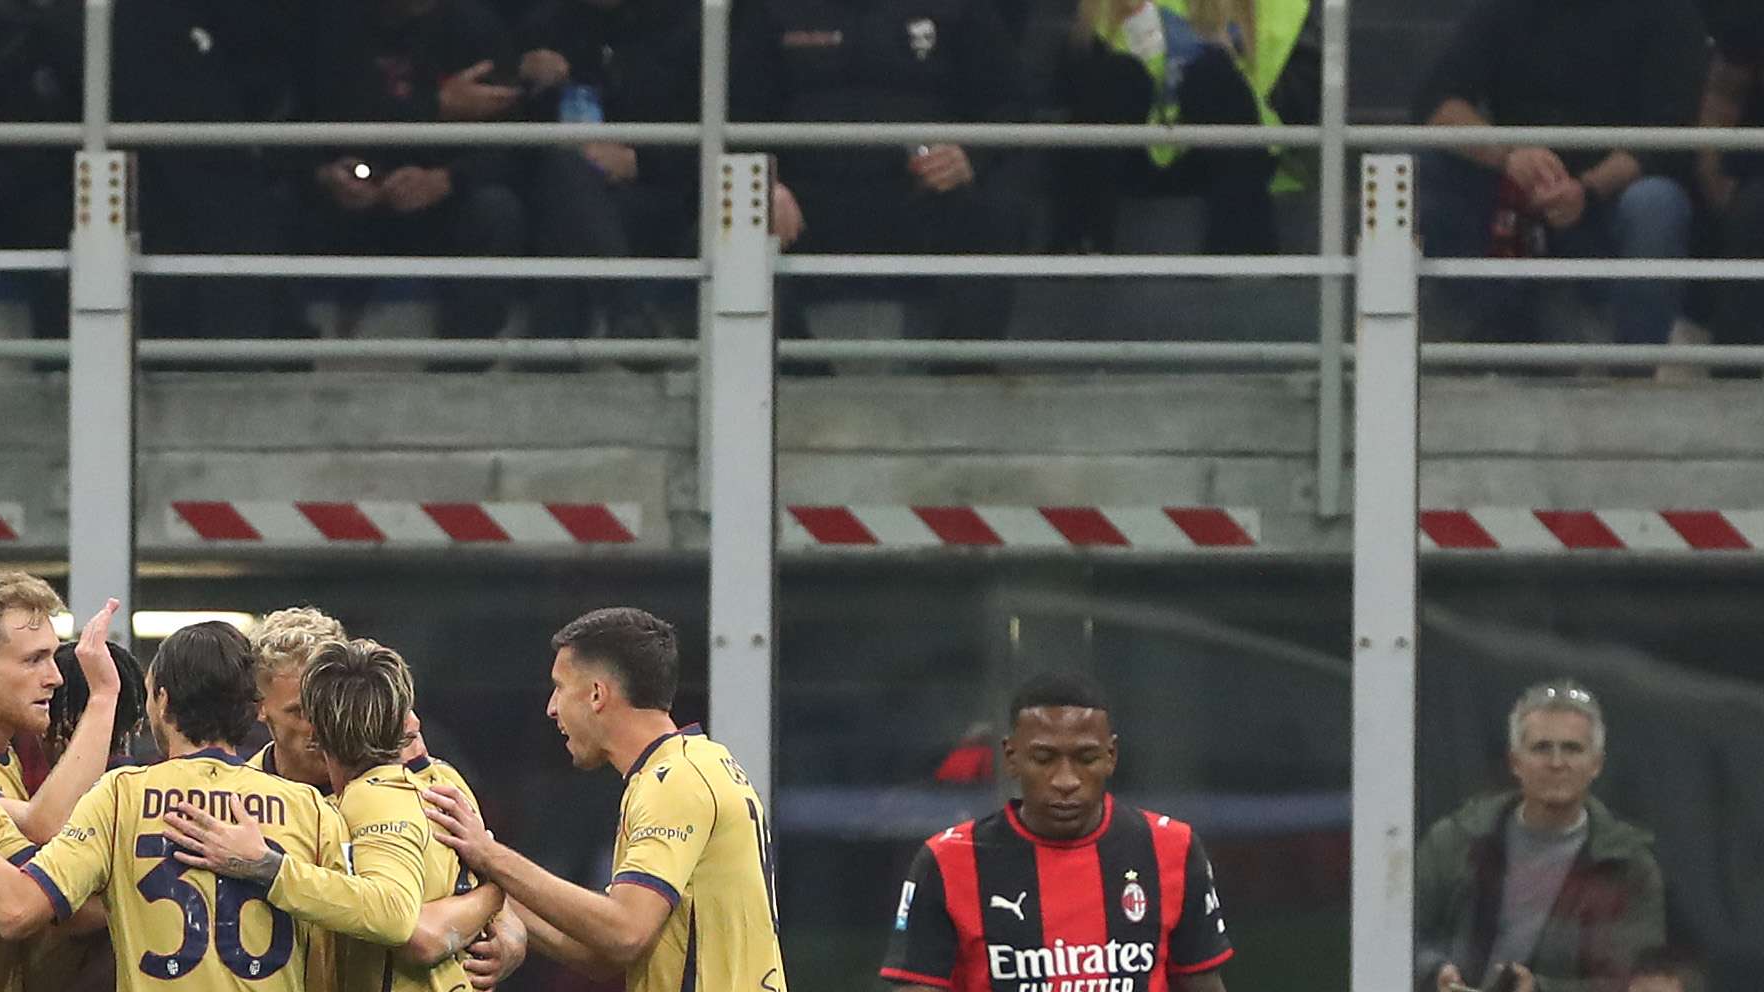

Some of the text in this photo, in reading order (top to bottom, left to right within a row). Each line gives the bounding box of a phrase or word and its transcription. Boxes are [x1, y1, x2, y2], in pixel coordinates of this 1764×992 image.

[142, 788, 286, 825] DARMAN
[135, 833, 294, 981] 36
[988, 938, 1154, 980] Emirates
